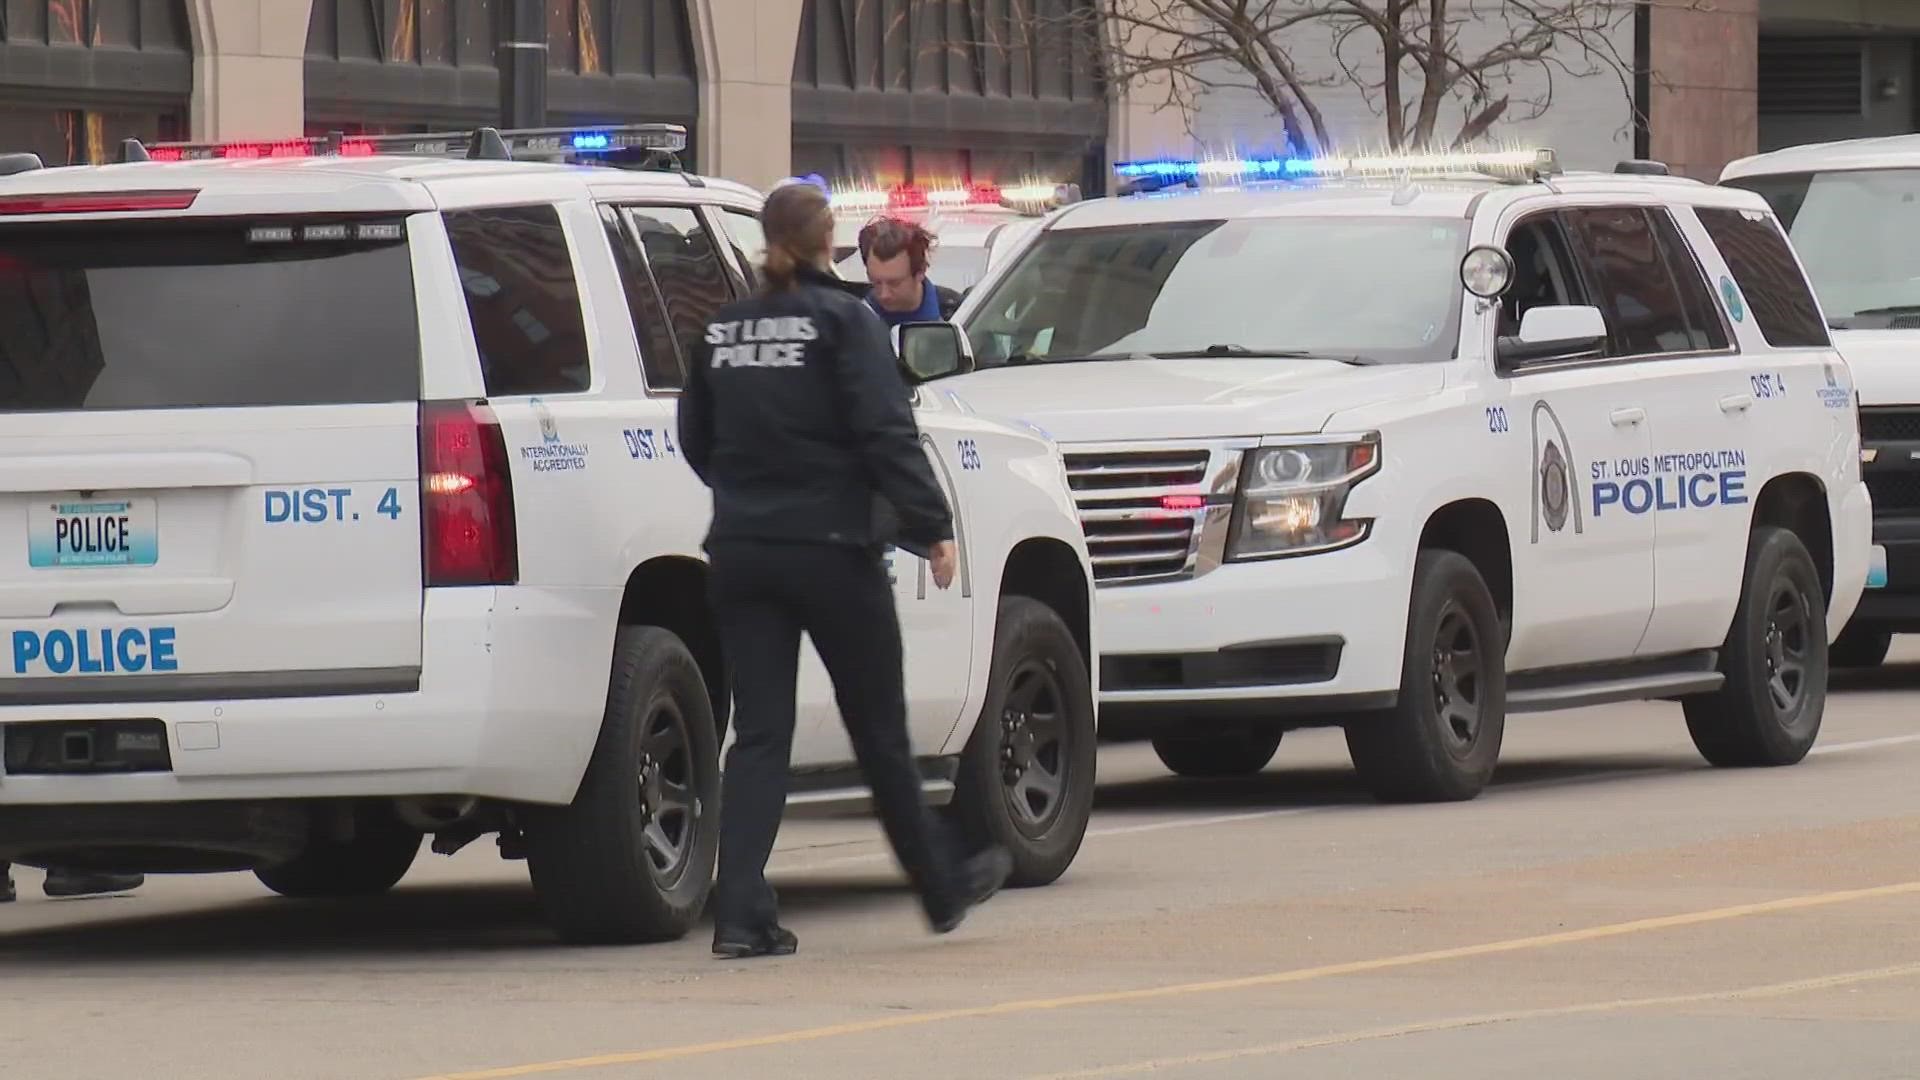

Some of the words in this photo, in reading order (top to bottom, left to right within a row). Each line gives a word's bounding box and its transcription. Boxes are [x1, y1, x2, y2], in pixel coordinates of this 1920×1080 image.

[704, 321, 741, 344] ST
[742, 316, 819, 341] LOUIS
[711, 343, 805, 368] POLICE
[1777, 372, 1786, 396] 4
[1485, 407, 1509, 432] 200
[520, 443, 589, 459] INTERNATIONALLY
[664, 429, 675, 458] 4
[533, 457, 586, 472] ACCREDITED
[1591, 460, 1611, 480] ST.
[1615, 456, 1650, 477] LOUIS
[1654, 450, 1746, 473] METROPOLITAN
[264, 489, 359, 522] DIST.
[377, 488, 402, 520] 4
[1592, 471, 1749, 517] POLICE
[56, 516, 130, 553] POLICE
[12, 627, 178, 674] POLICE
